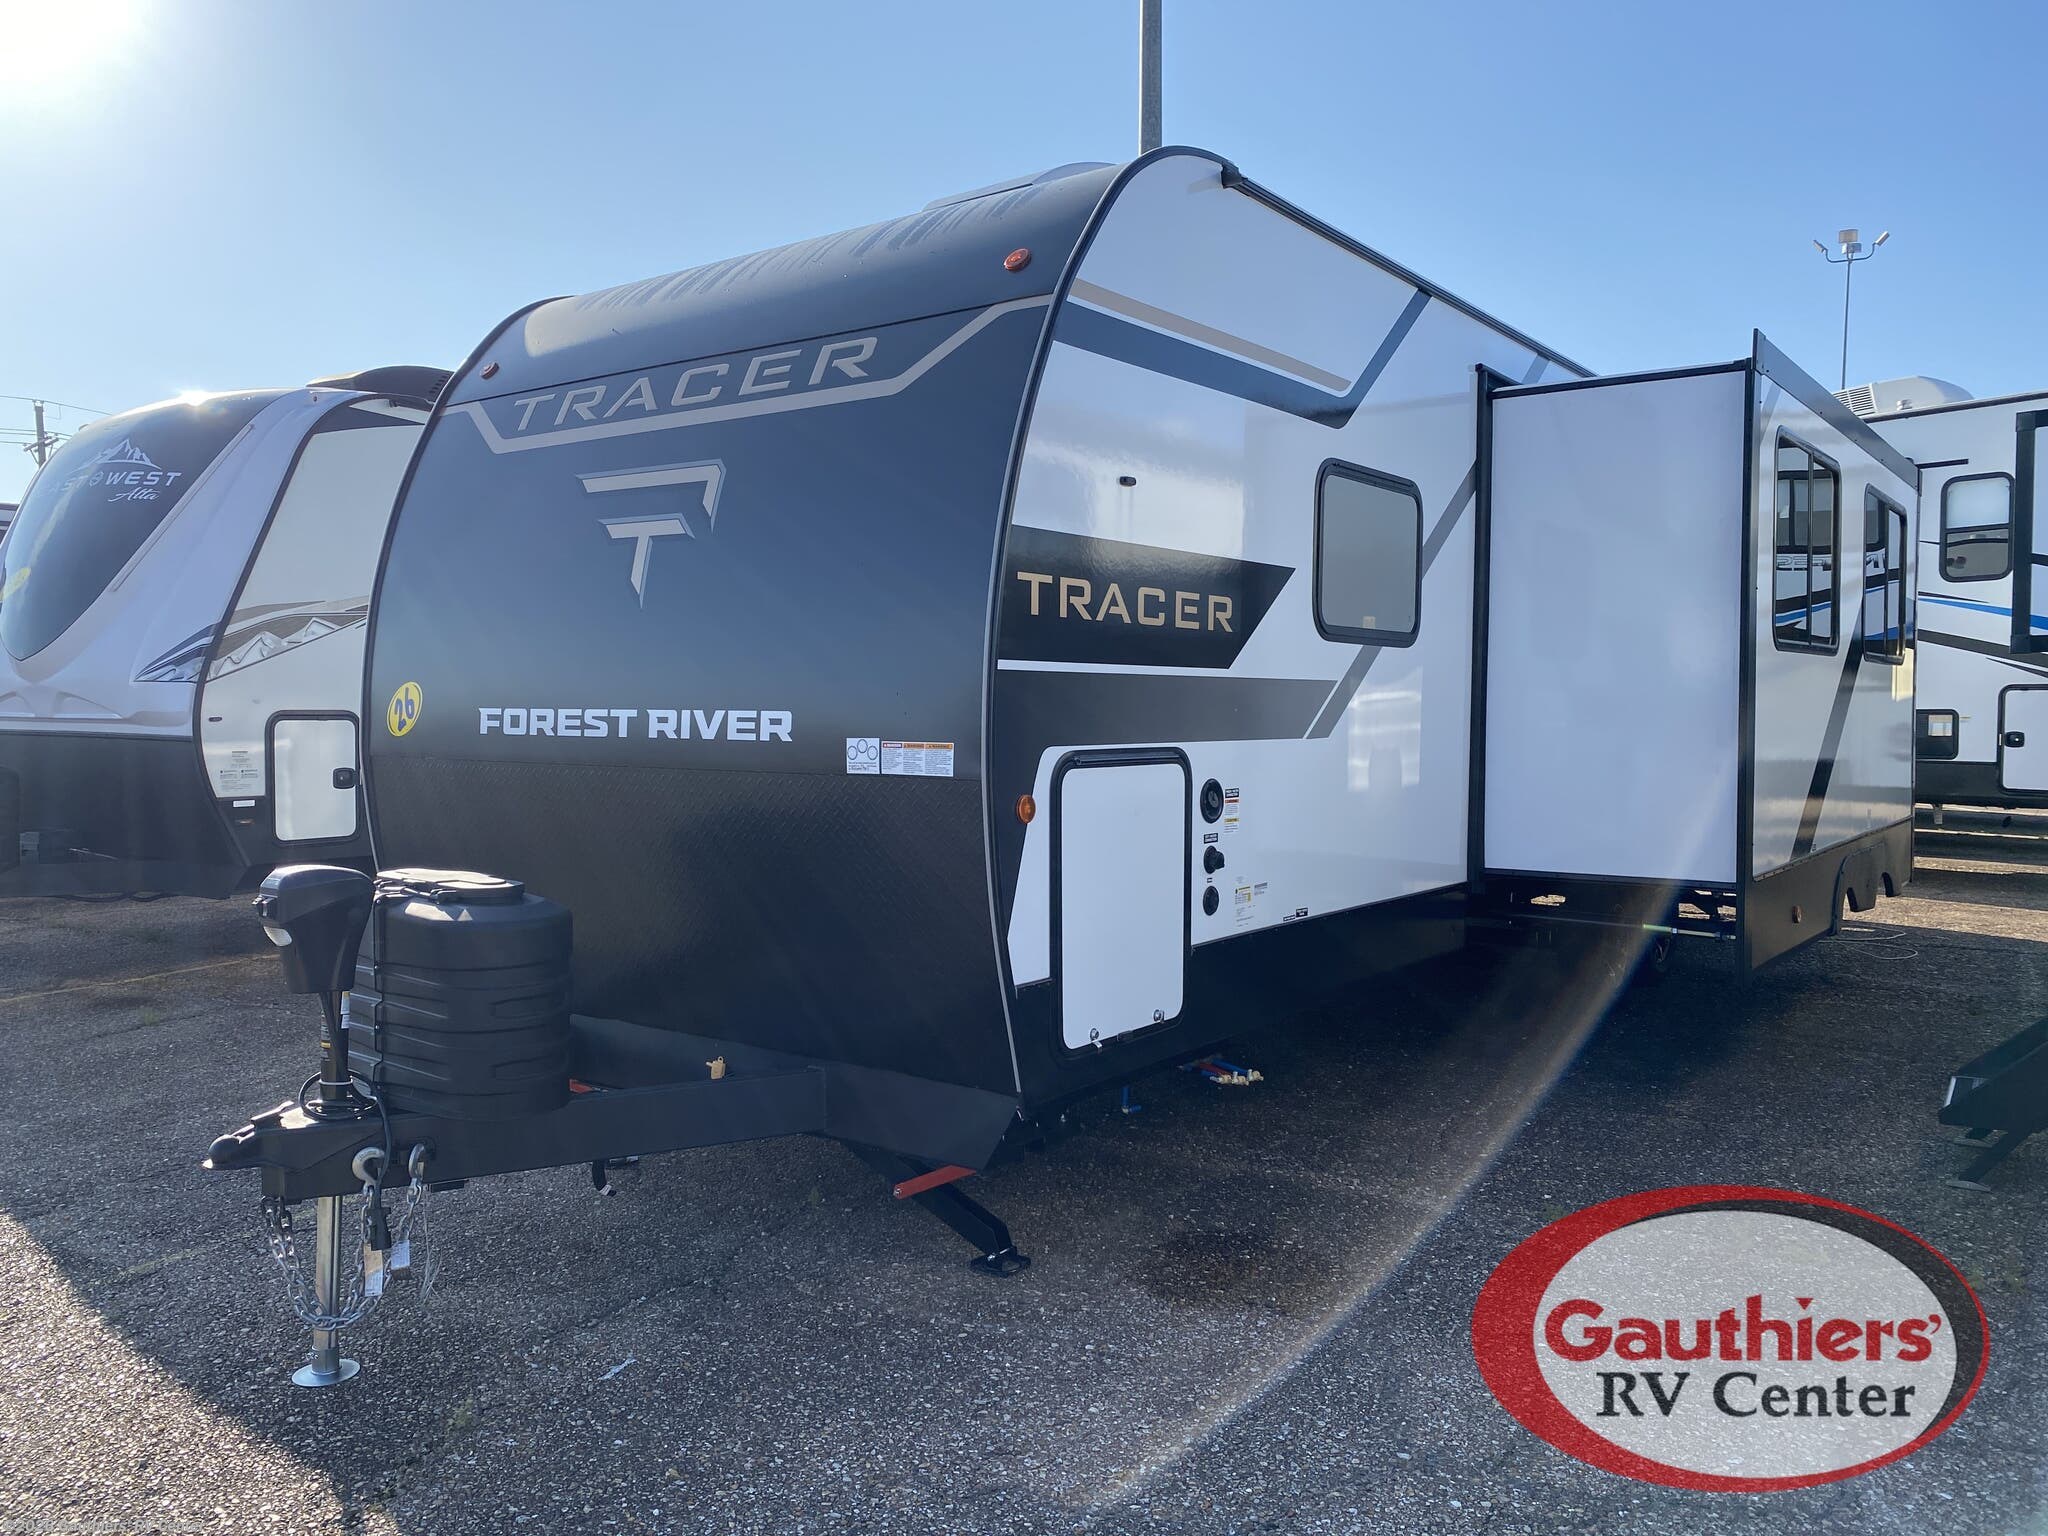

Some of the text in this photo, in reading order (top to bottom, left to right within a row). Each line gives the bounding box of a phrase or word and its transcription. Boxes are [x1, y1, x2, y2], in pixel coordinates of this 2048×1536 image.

[513, 337, 878, 432] TRACER
[1017, 571, 1234, 633] TRACER
[478, 707, 793, 742] FOREST RIVER
